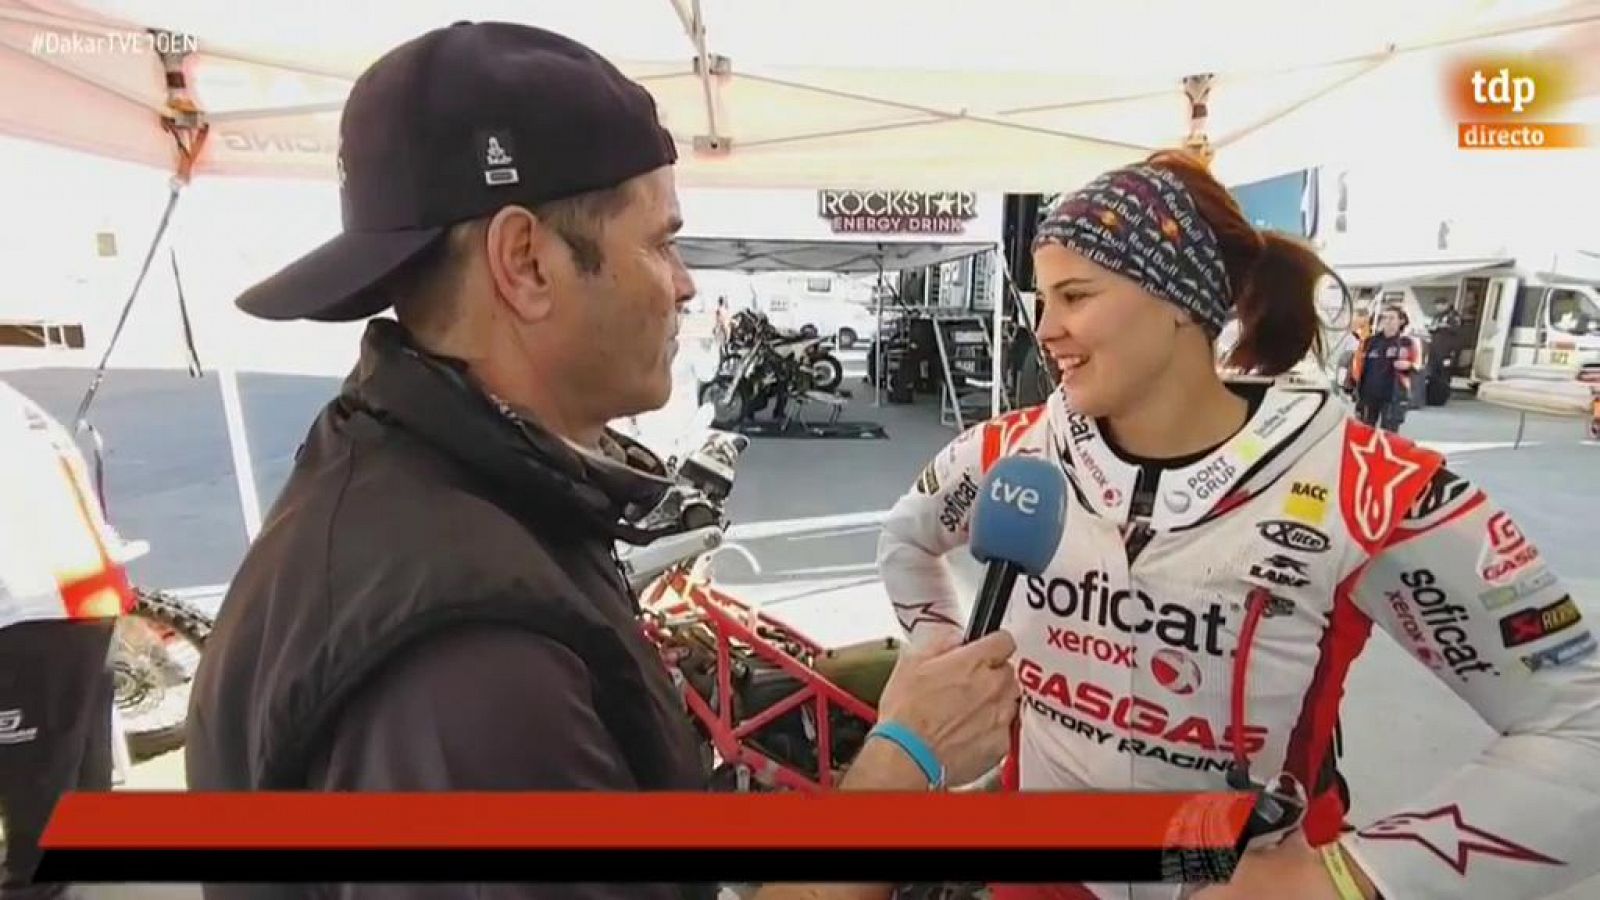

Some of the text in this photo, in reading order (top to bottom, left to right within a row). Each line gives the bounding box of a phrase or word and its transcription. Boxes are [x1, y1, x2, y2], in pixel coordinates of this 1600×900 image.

[832, 216, 964, 232] ENERGY DRINK
[1186, 455, 1228, 490] PONT
[1196, 466, 1237, 500] GRUP
[990, 477, 1040, 514] tve
[1290, 481, 1329, 502] RACC
[1047, 625, 1138, 668] xerox
[1017, 657, 1269, 755] GASGAS
[1022, 692, 1114, 745] ACTORY
